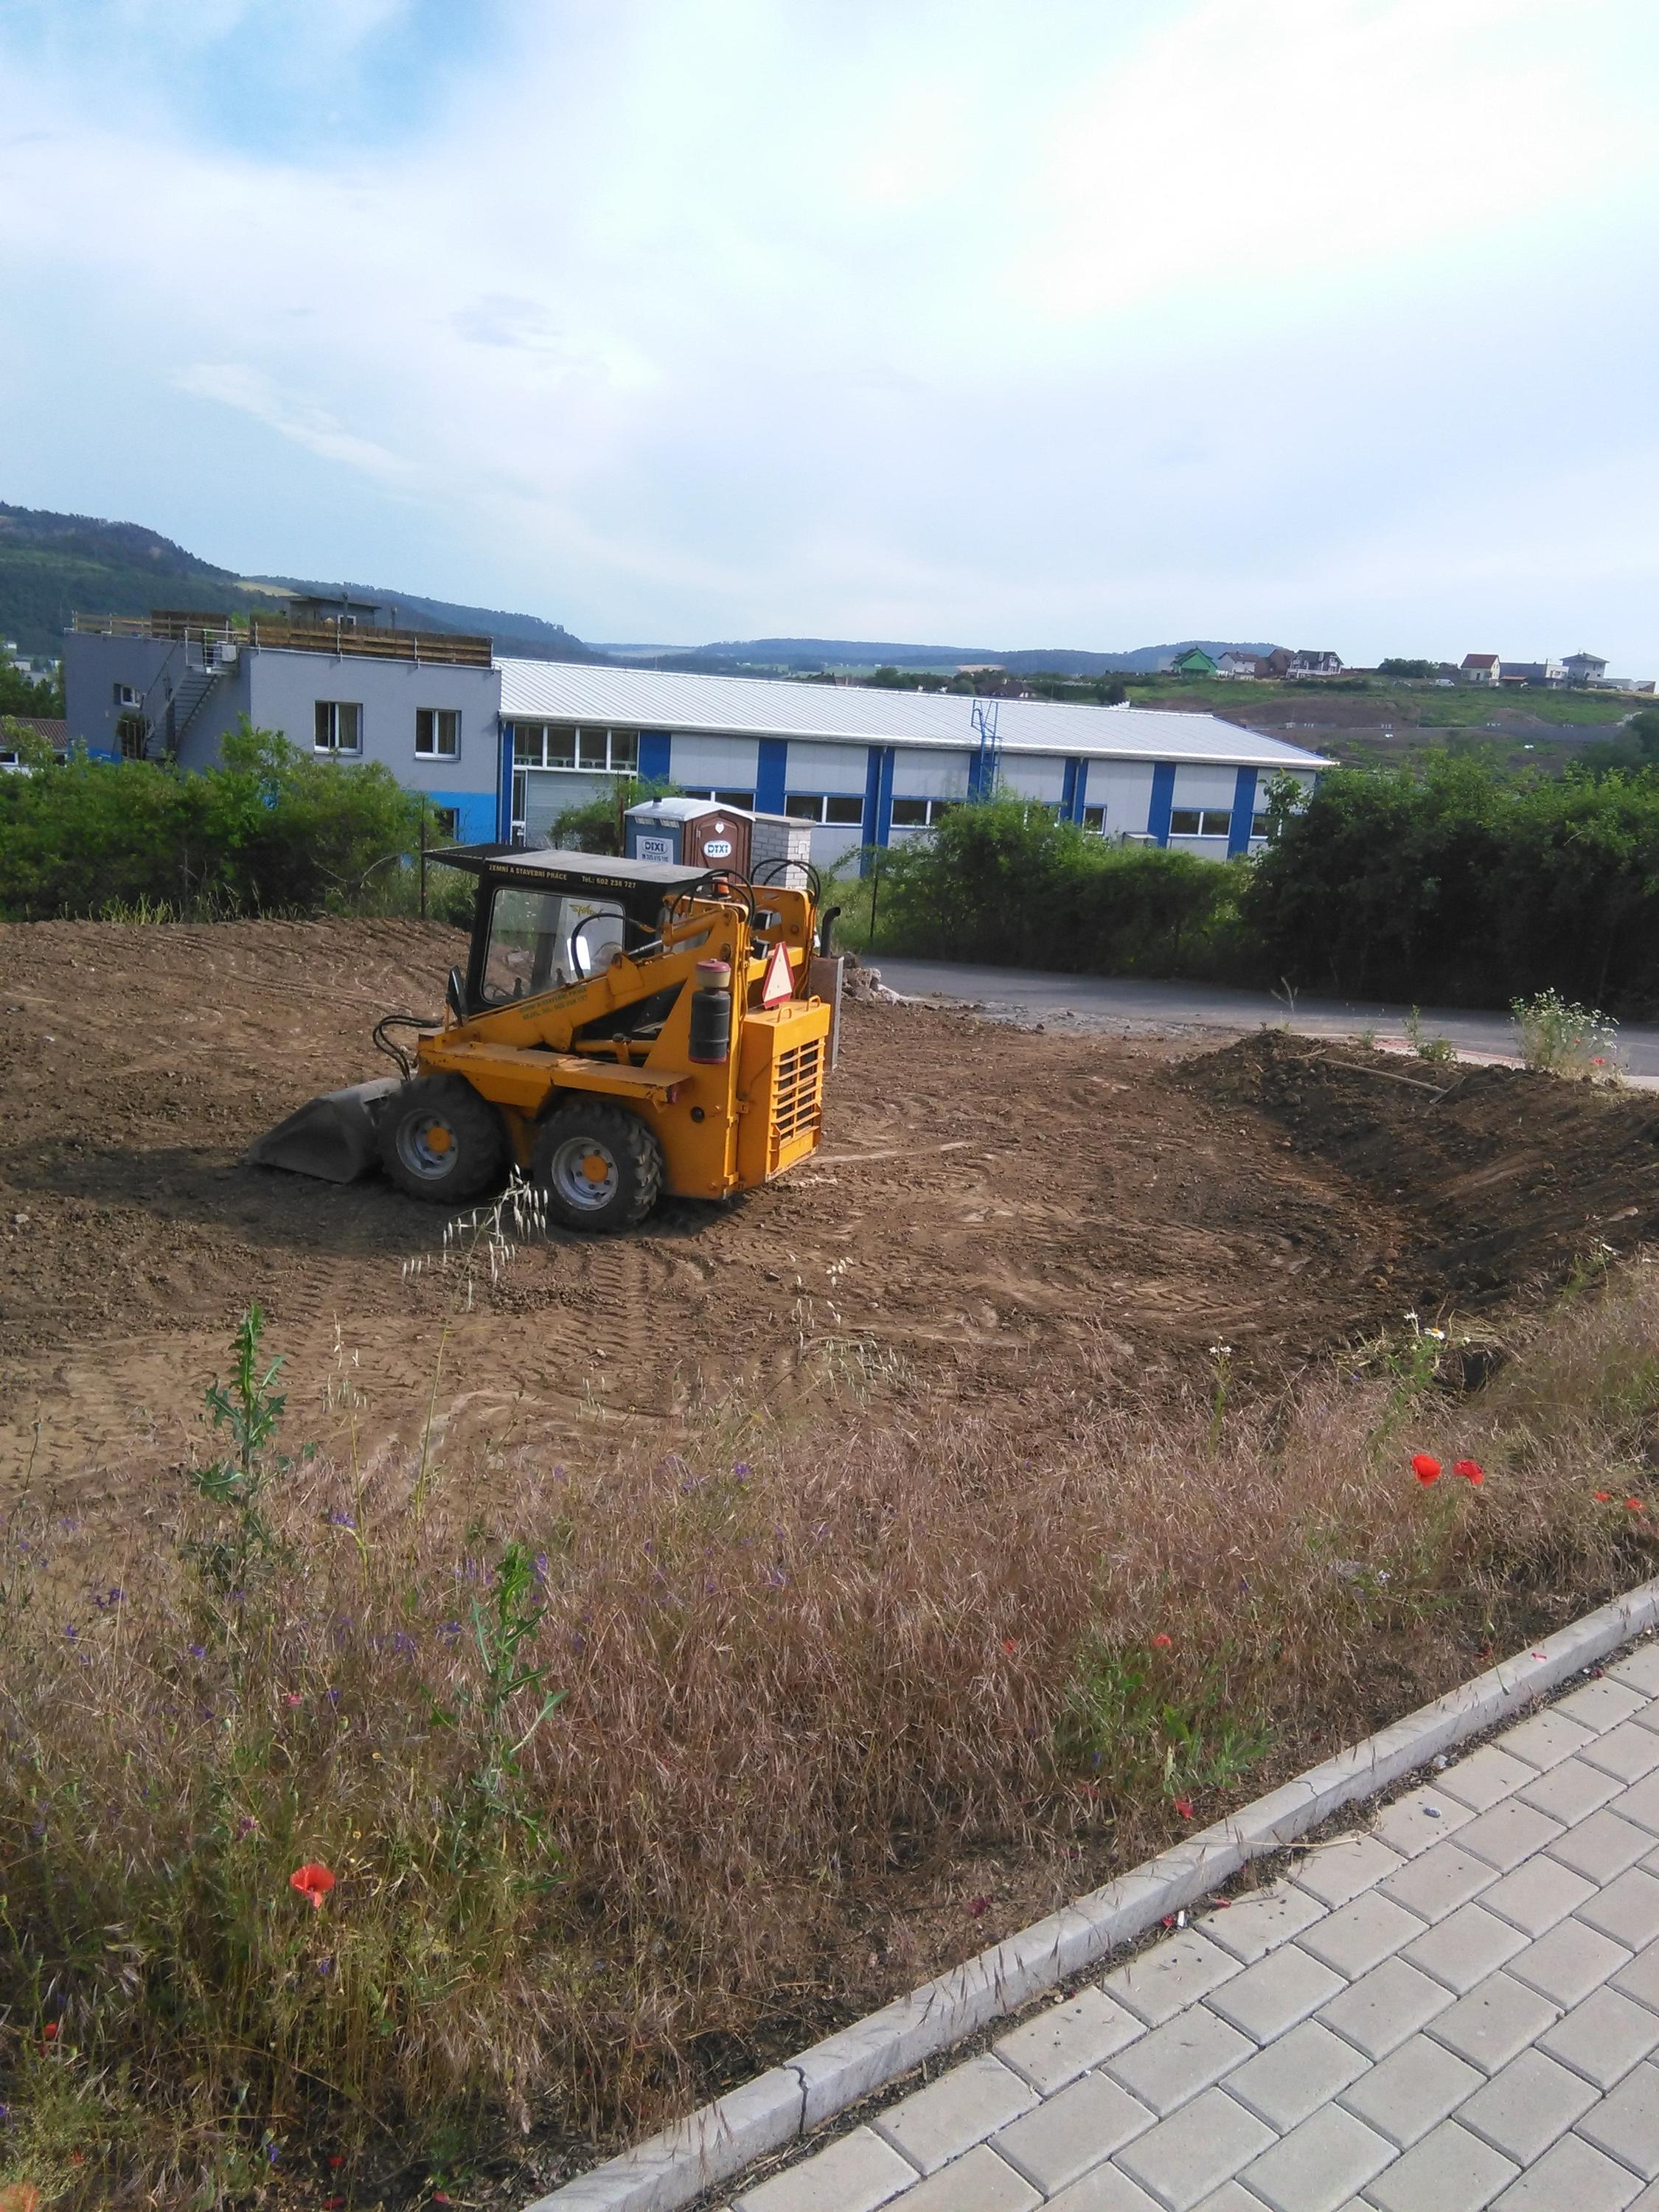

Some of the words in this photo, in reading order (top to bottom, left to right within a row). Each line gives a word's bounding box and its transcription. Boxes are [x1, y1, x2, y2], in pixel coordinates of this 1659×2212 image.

[644, 841, 664, 852] DIXI
[708, 844, 728, 853] DIXI
[515, 867, 545, 877] STAVEBNÍ
